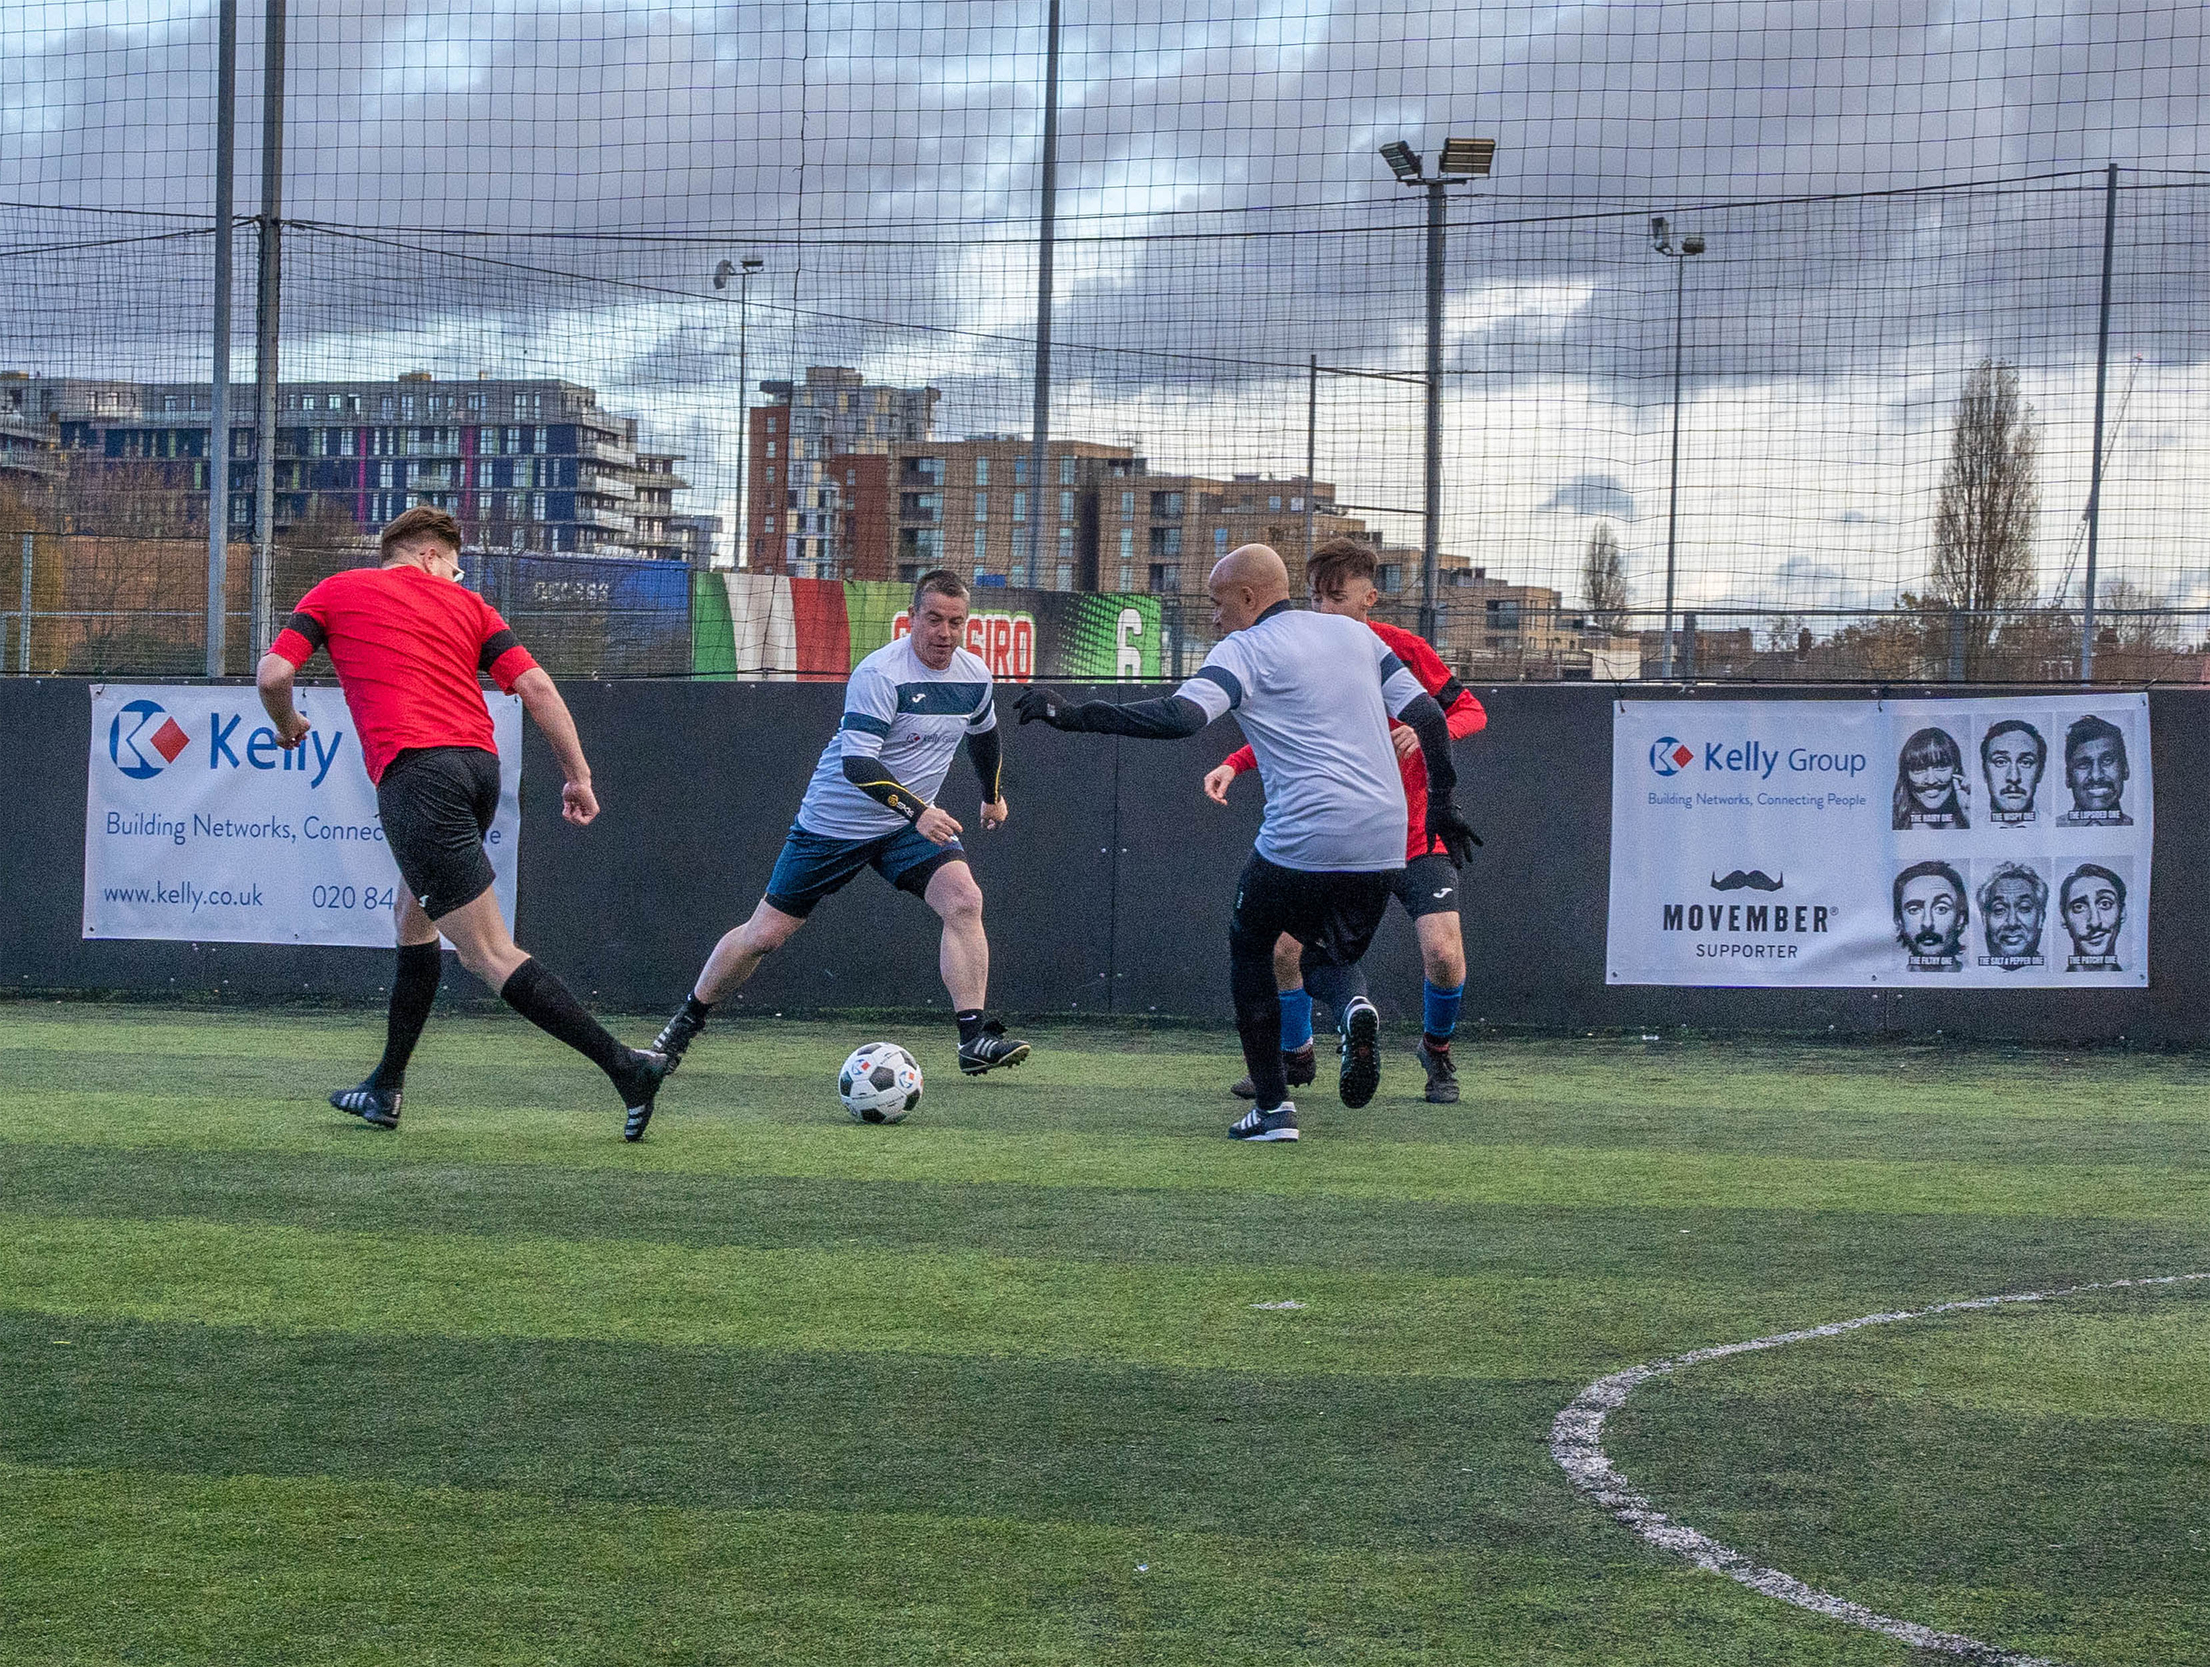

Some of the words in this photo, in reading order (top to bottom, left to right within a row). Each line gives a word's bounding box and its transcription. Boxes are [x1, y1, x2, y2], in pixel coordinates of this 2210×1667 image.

[1117, 608, 1143, 683] 6
[1705, 741, 1779, 780] Kelly
[1788, 748, 1867, 778] Group
[1648, 792, 1692, 810] Building
[1696, 793, 1753, 806] Networks,
[1757, 793, 1824, 810] Connecting
[1828, 793, 1867, 807] People
[106, 811, 186, 846] Building
[193, 813, 297, 844] Networks,
[303, 816, 385, 842] Connec
[104, 880, 263, 914] www.kelly.co.uk
[312, 885, 356, 909] 020
[364, 886, 395, 911] 84
[1696, 943, 1798, 959] SUPPORTER
